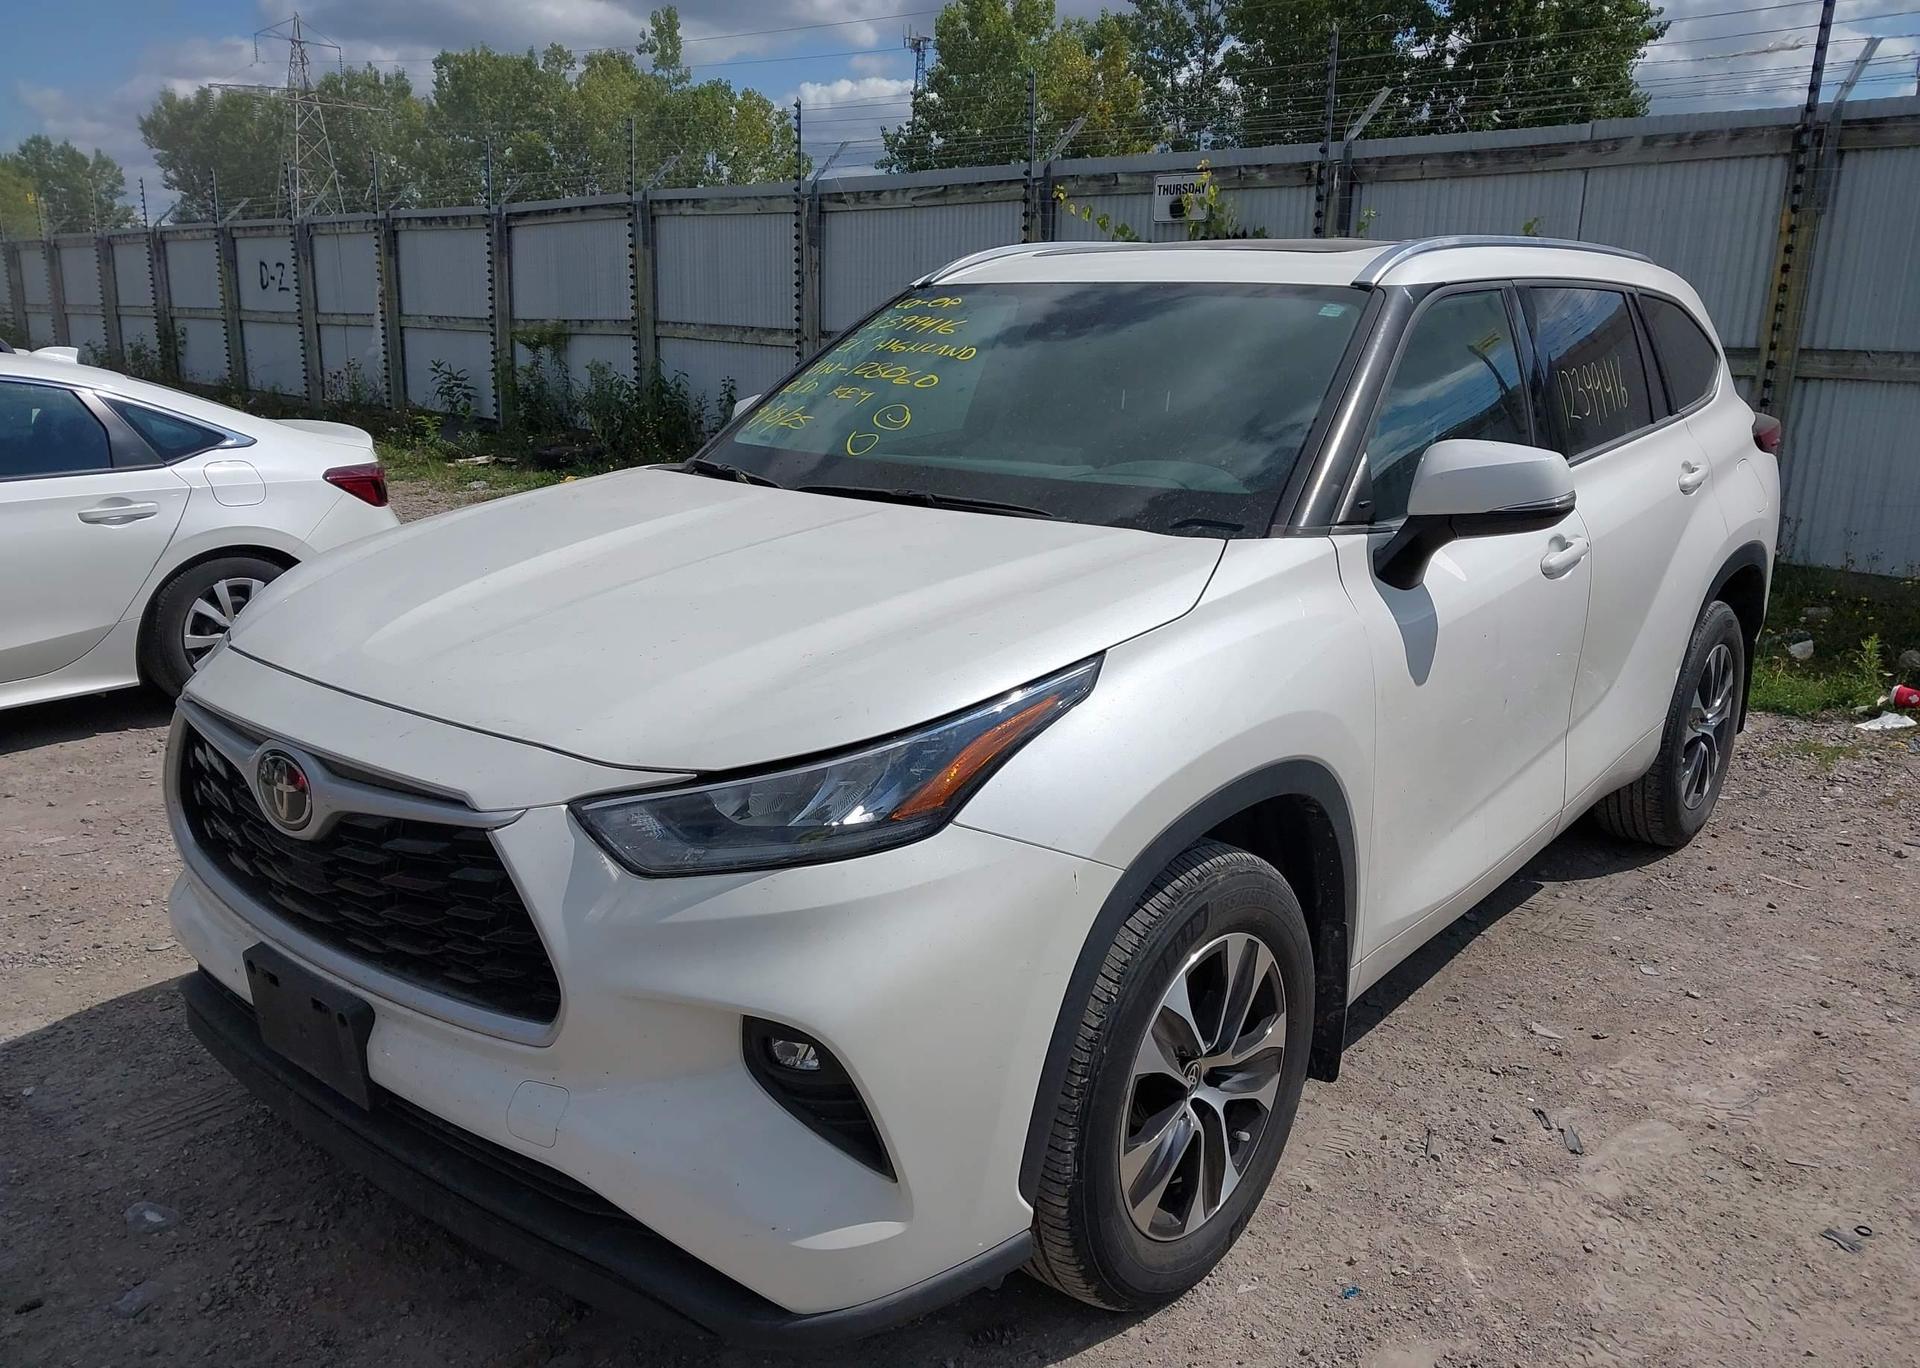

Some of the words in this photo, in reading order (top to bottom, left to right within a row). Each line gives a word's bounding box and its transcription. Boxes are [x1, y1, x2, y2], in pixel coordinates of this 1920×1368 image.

[1157, 183, 1207, 196] THURSDAY
[870, 337, 978, 361] HIGHLAND
[827, 384, 876, 407] KEY
[1556, 355, 1629, 429] 12399416
